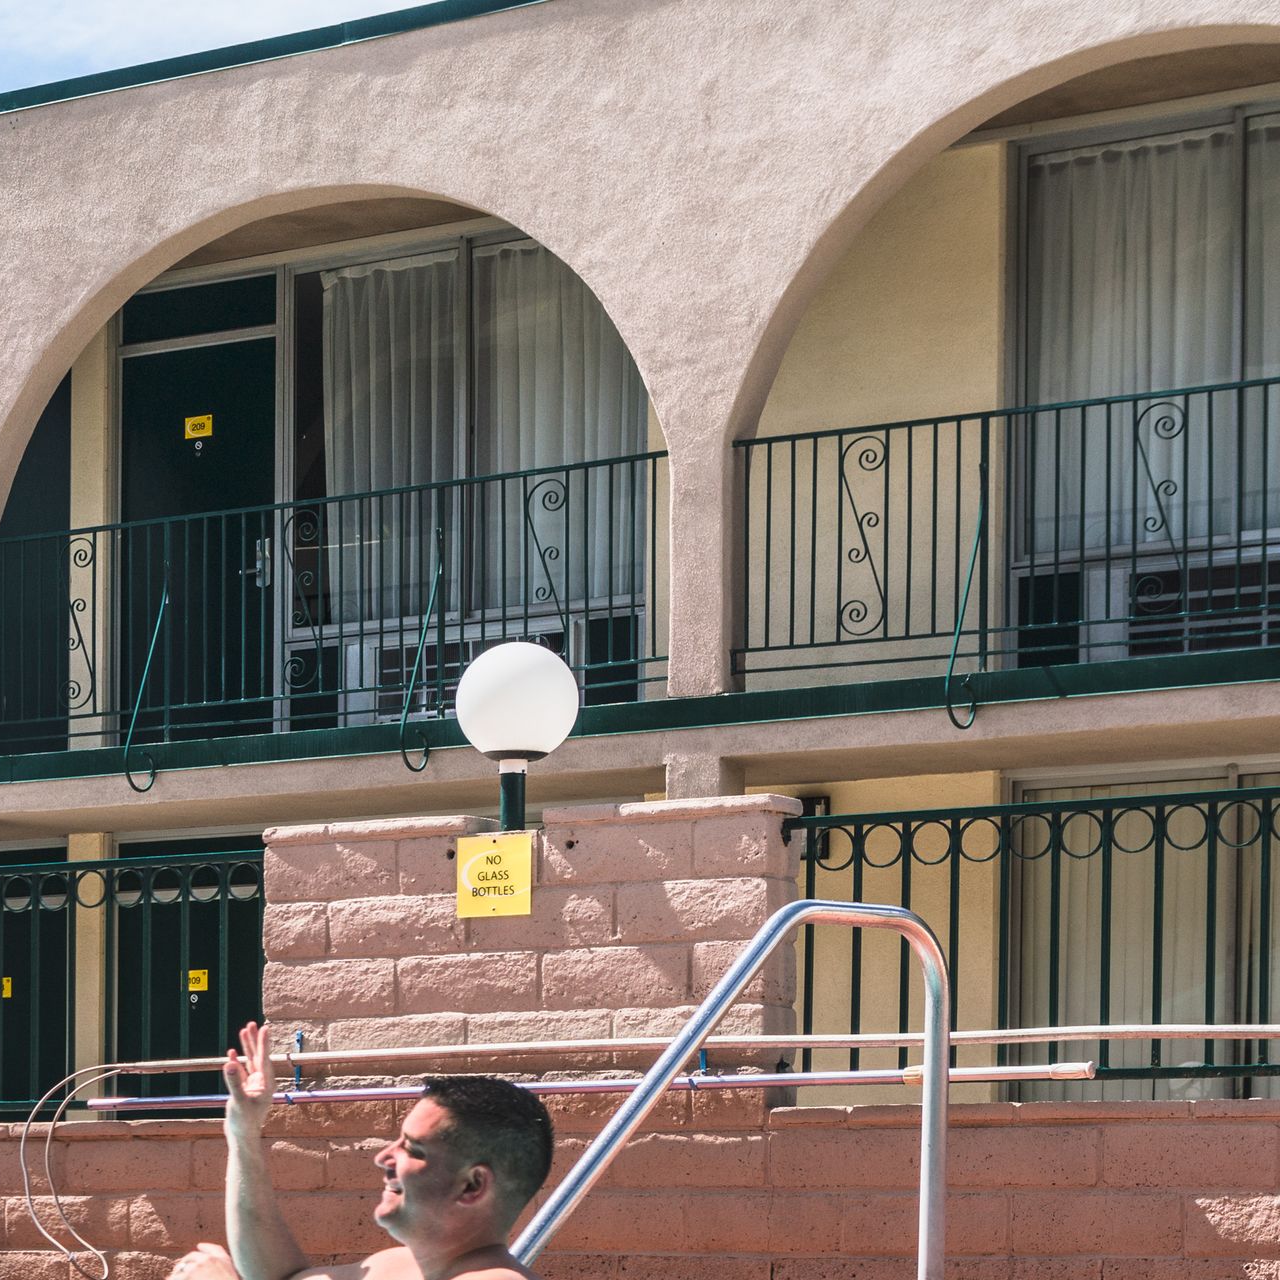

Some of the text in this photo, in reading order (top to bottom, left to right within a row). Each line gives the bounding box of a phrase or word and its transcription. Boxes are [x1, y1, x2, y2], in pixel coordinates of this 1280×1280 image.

[192, 422, 205, 431] 209
[486, 855, 502, 865] NO
[477, 870, 509, 882] GLASS
[472, 885, 515, 897] BOTTLES
